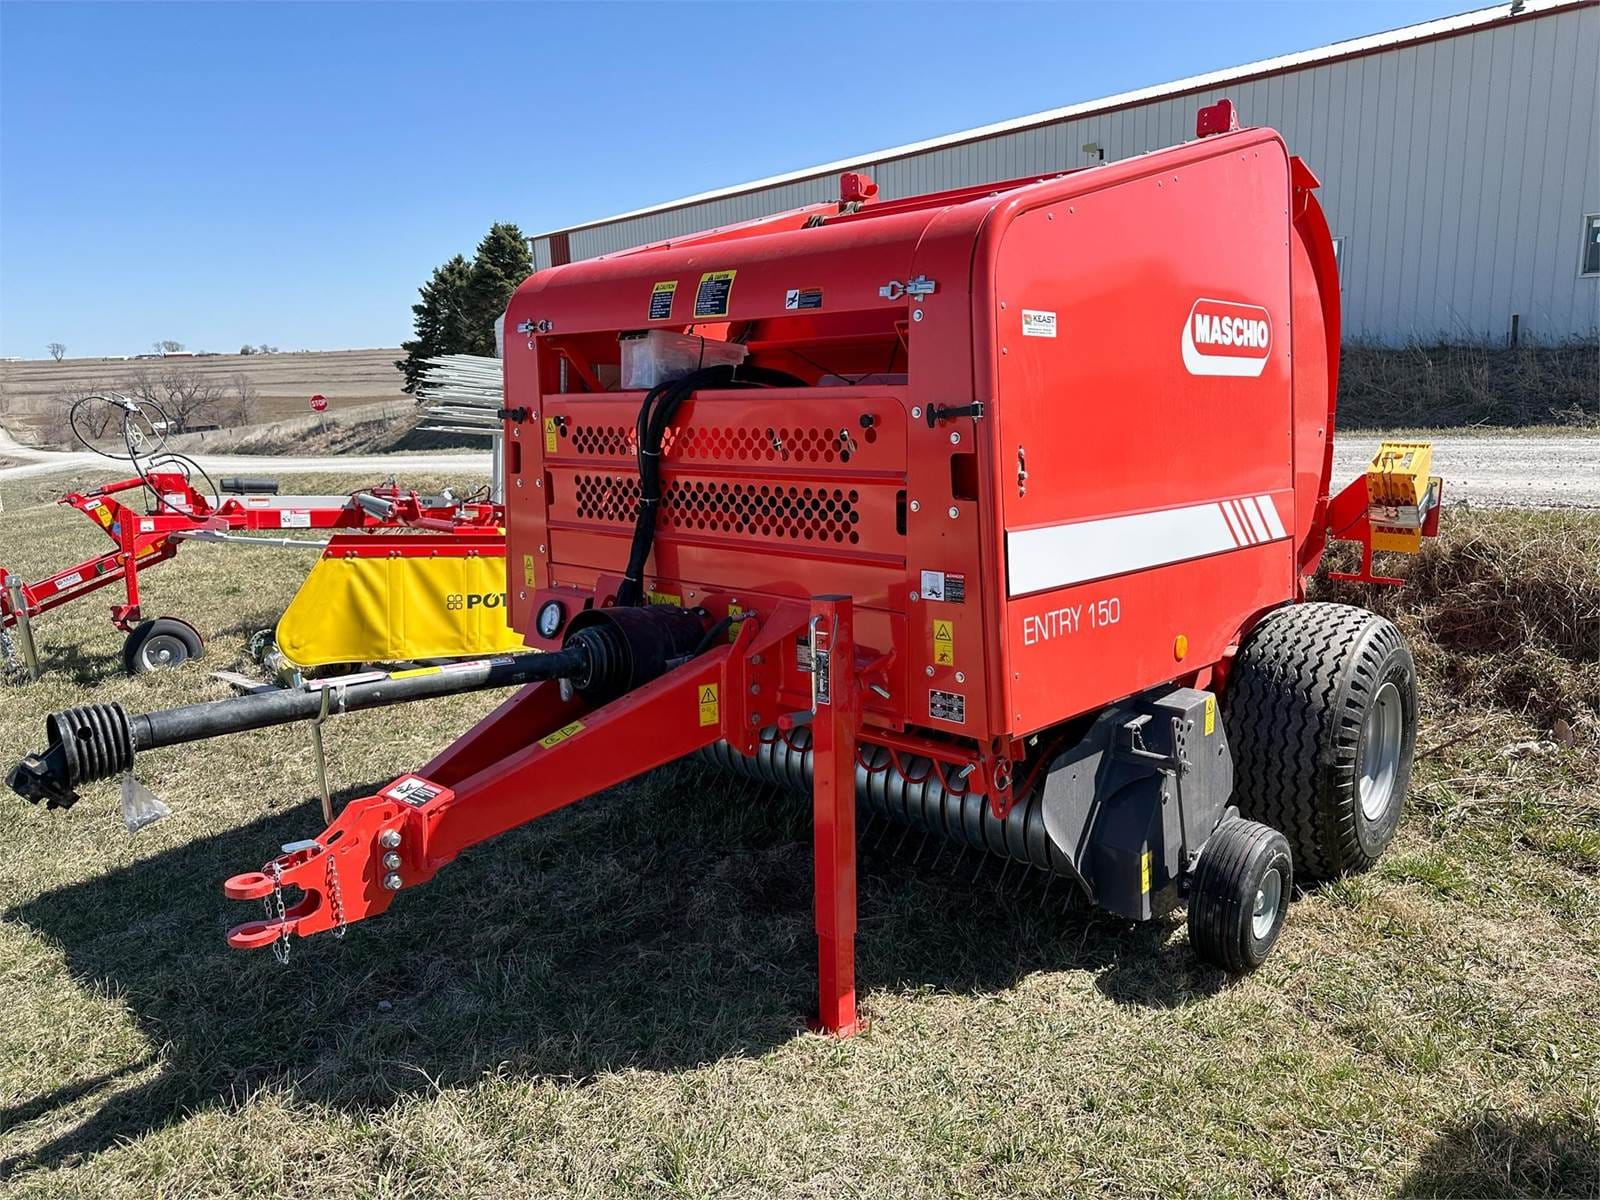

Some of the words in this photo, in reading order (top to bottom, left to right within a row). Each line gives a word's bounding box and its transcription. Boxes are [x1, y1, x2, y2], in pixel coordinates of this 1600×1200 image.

[1033, 314, 1055, 323] KEAST
[1195, 313, 1269, 348] MASCHIO
[311, 399, 326, 407] STOP
[1023, 604, 1082, 646] ENTRY
[1088, 597, 1120, 628] 150
